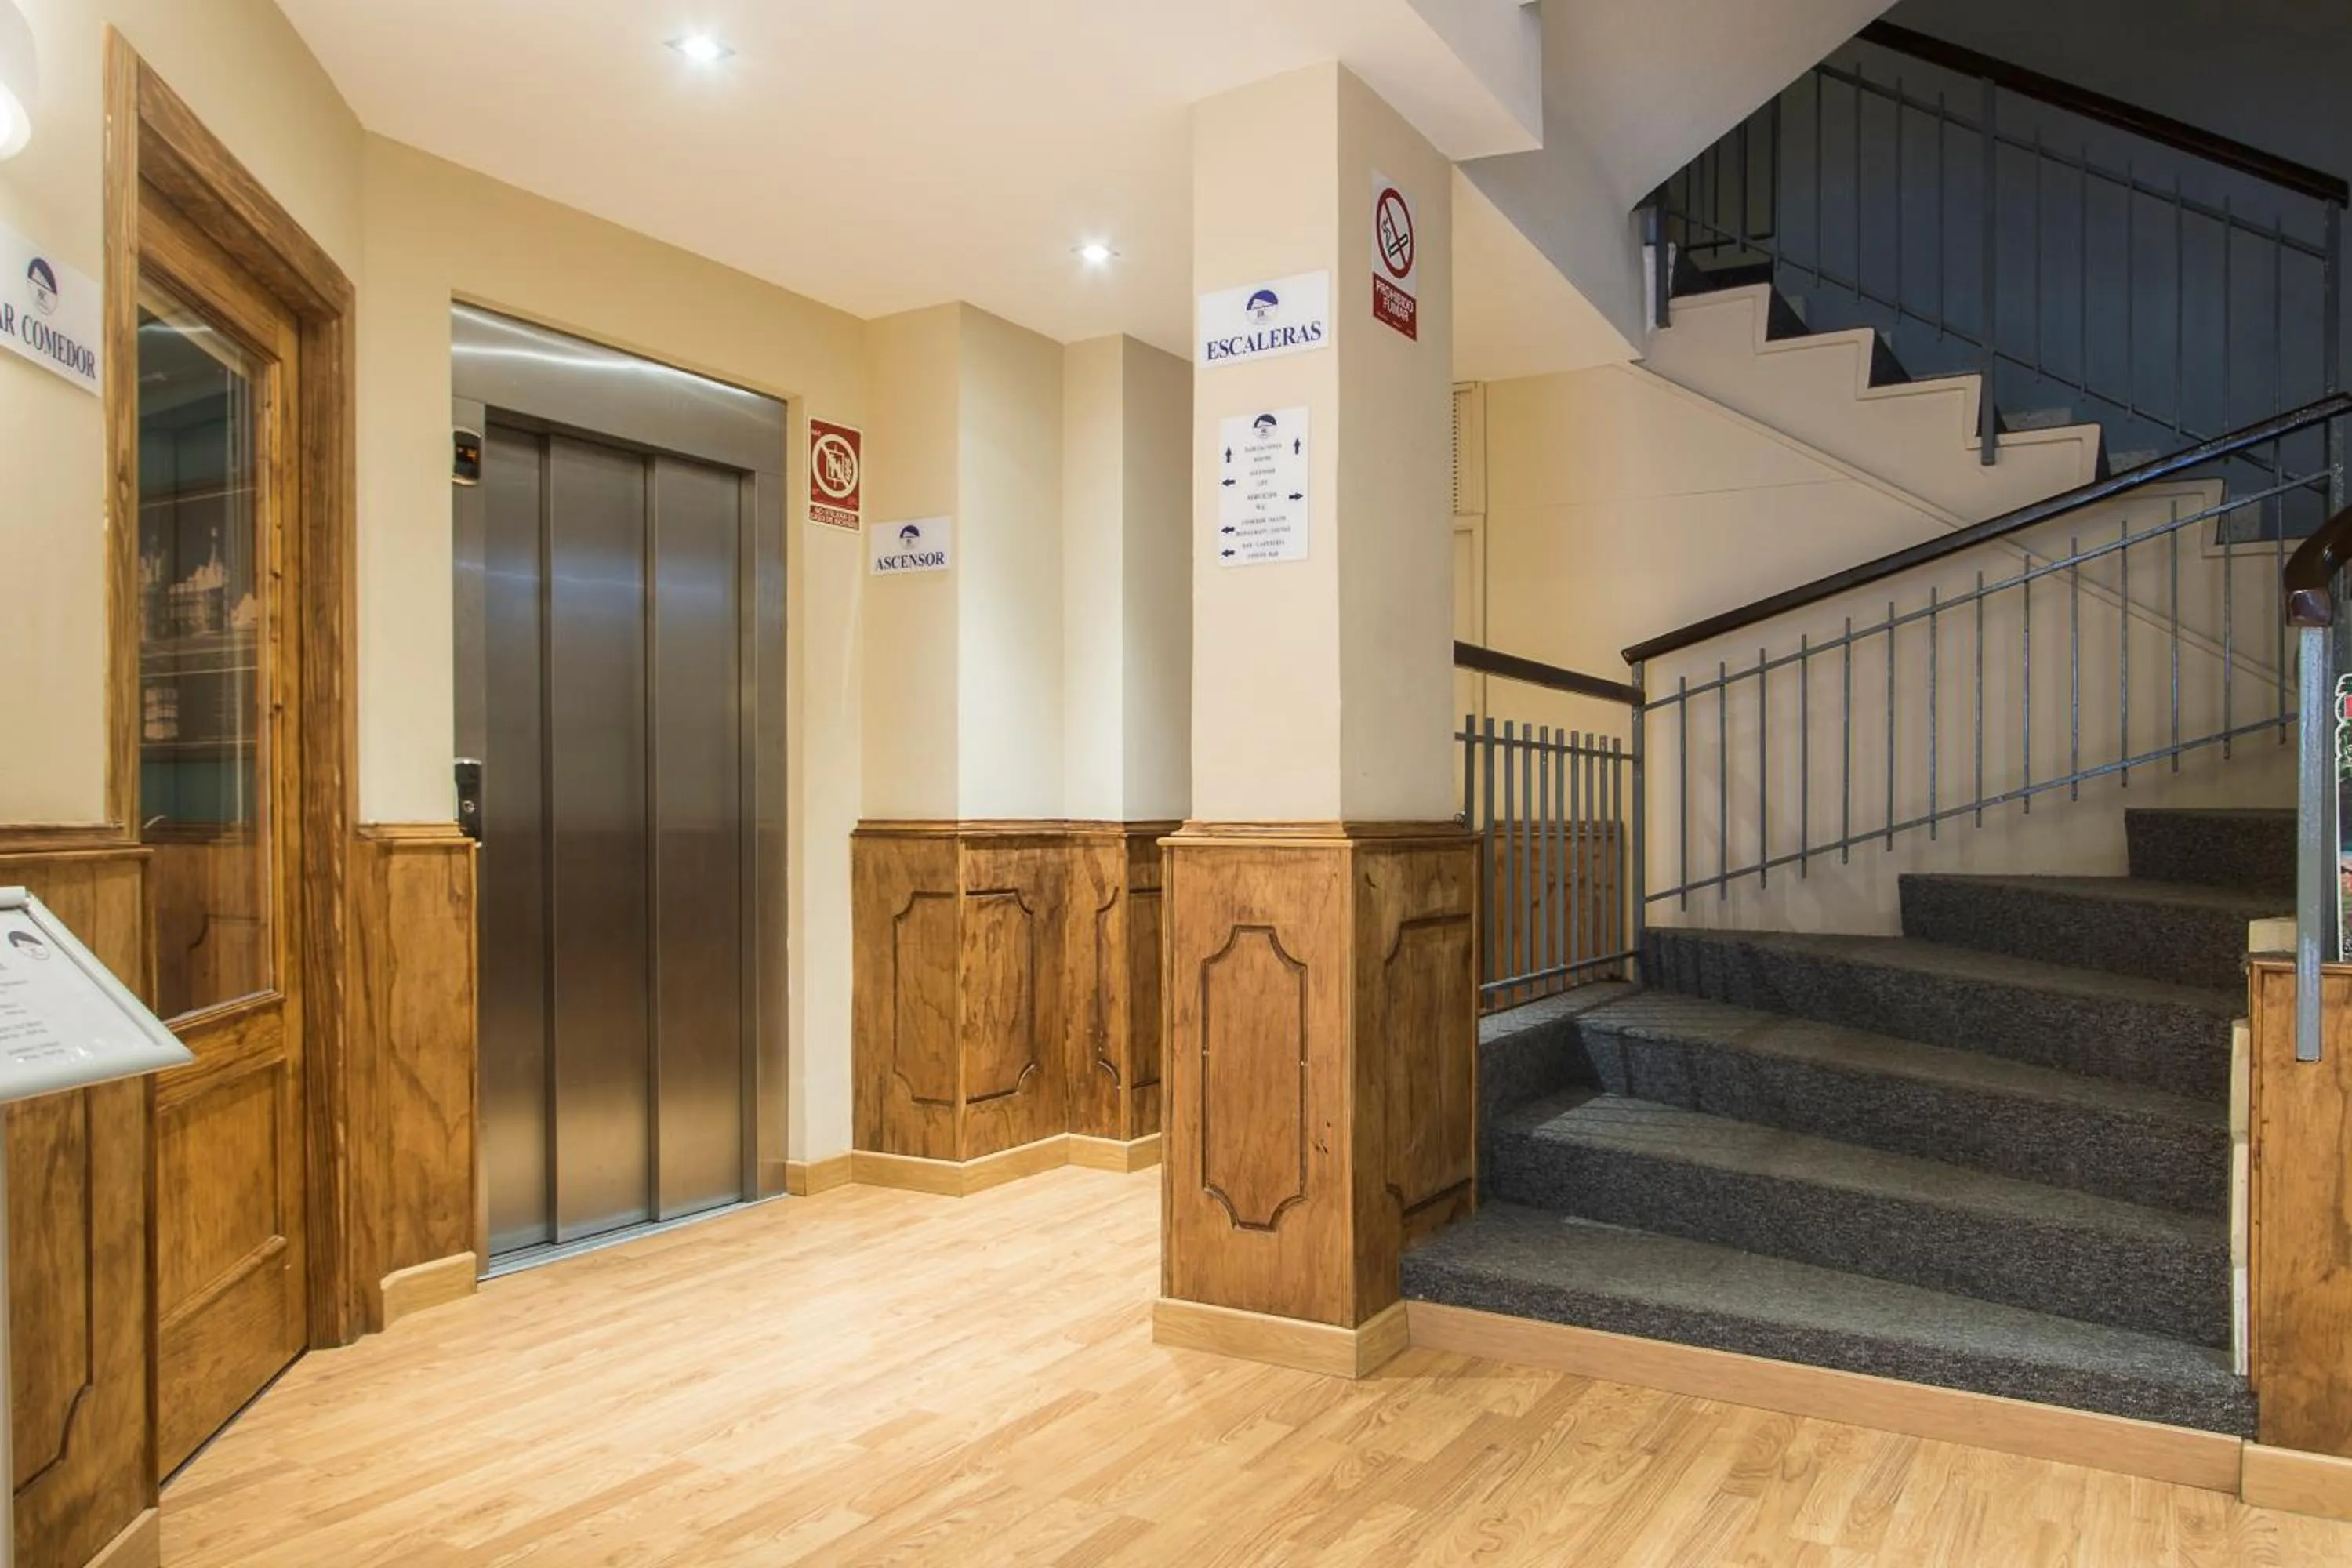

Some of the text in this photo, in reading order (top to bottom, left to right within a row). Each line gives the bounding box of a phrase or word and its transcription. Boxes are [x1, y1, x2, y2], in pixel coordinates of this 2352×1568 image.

[22, 314, 96, 379] COMEDOR
[1207, 321, 1322, 361] ESCALERAS
[876, 551, 945, 571] ASCENSOR
